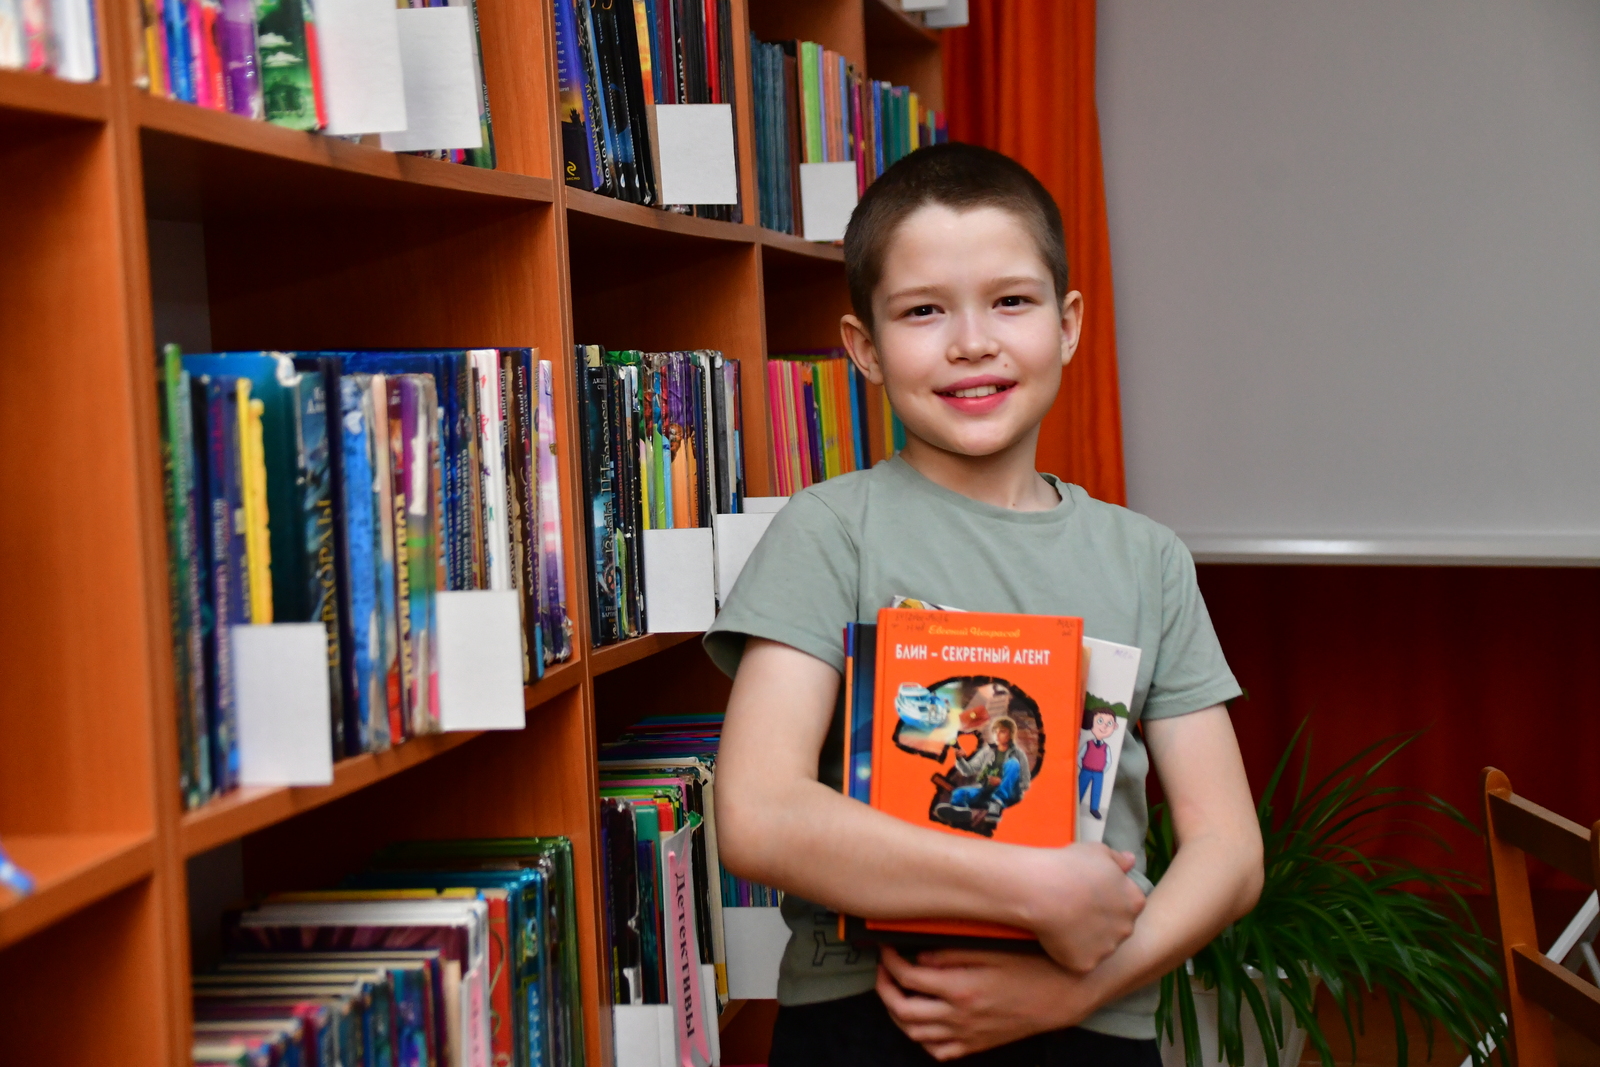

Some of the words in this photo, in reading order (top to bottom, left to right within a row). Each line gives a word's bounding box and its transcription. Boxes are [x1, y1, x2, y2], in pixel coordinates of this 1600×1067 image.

[970, 626, 1021, 638] Некрасов
[895, 643, 927, 660] БЛИН
[941, 645, 1010, 664] СЕКРЕТНЫЙ
[1013, 648, 1050, 665] АГЕНТ
[674, 870, 696, 1038] Детективы
